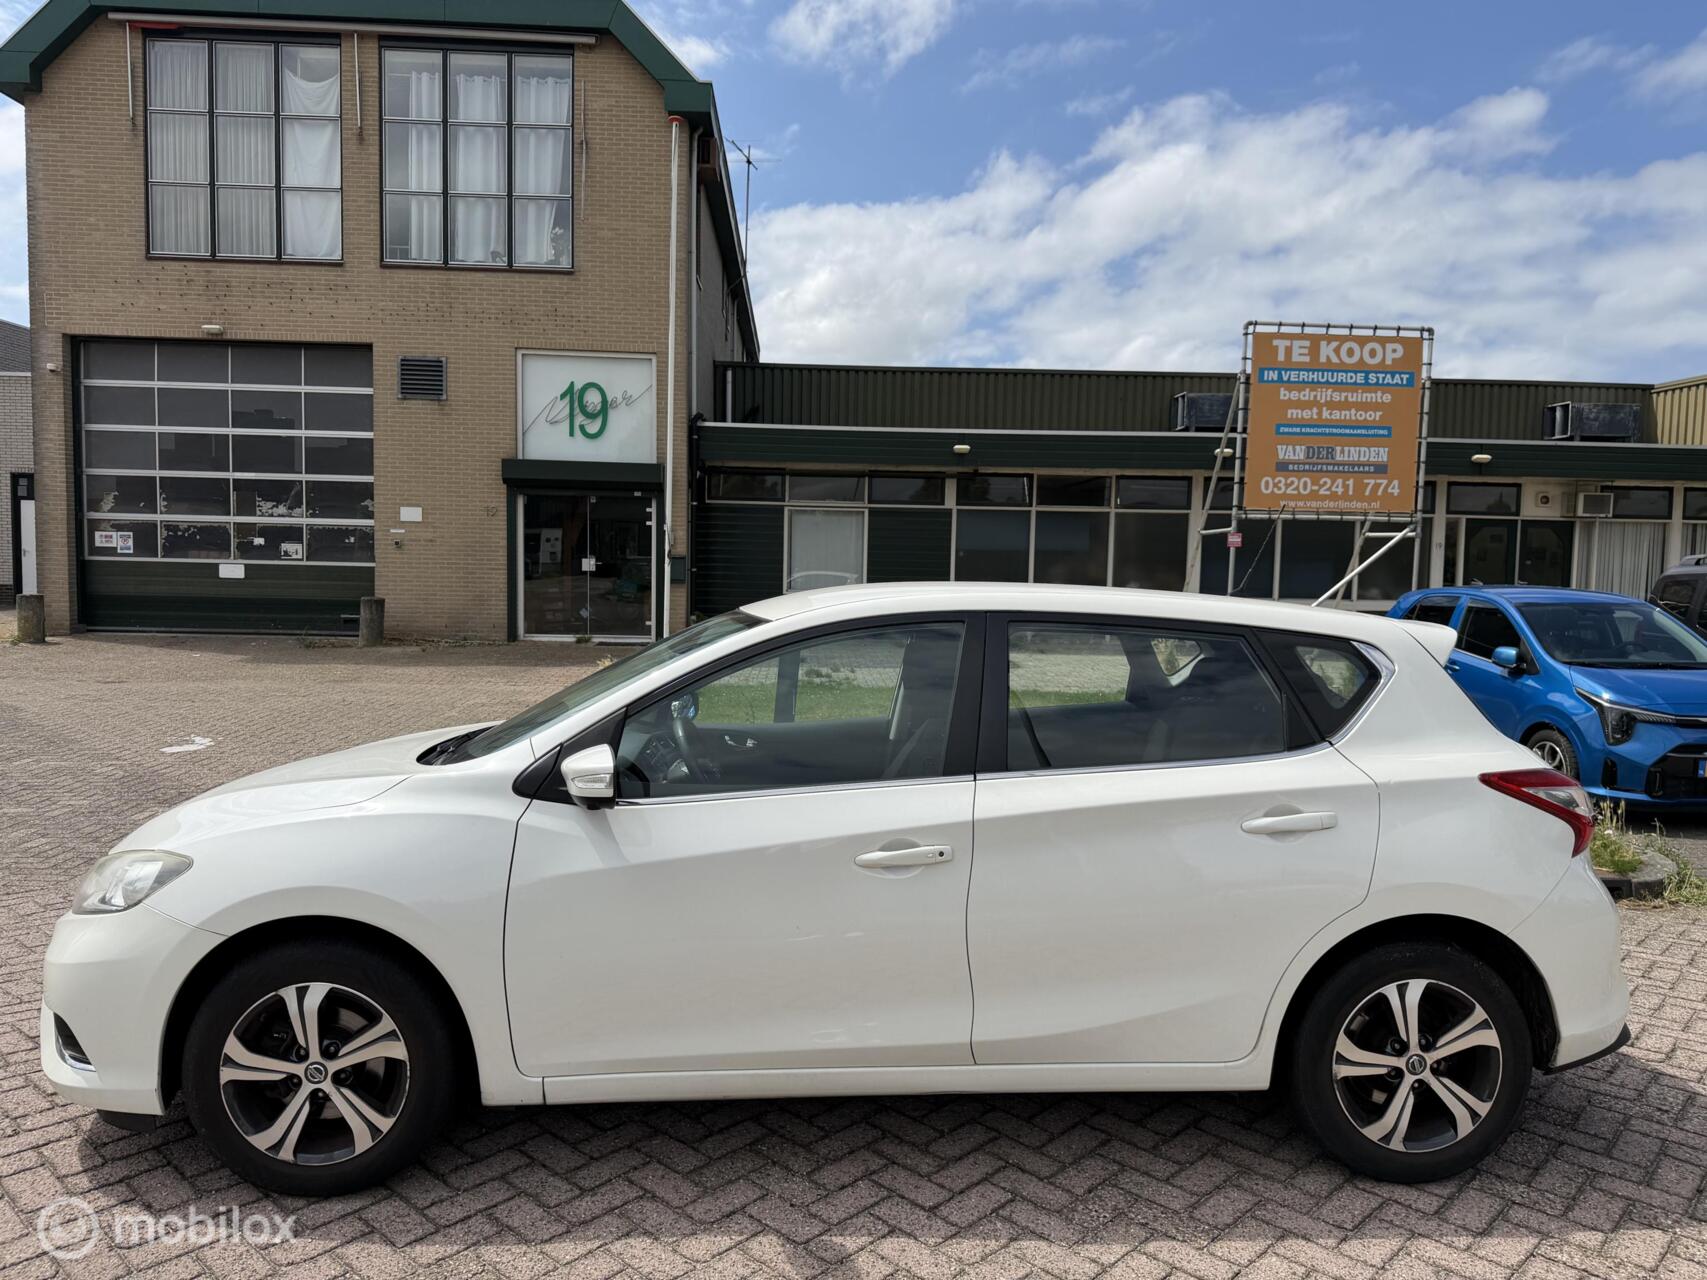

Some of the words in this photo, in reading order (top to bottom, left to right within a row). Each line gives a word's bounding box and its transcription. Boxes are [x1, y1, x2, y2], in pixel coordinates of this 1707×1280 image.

[1272, 339, 1310, 363] TE
[1319, 340, 1404, 365] KOOP
[1263, 370, 1278, 381] IN
[1281, 370, 1365, 384] VERHUURDE
[1368, 373, 1410, 385] STAAT
[1279, 387, 1392, 403] bedrijfsruimte
[560, 380, 609, 440] 19
[1287, 407, 1318, 419] met
[1322, 406, 1382, 421] kantoor
[1288, 464, 1375, 473] BEDRIJFSMAKELAARS
[1260, 476, 1355, 495] 0320-241
[1363, 479, 1400, 497] 774
[1280, 499, 1380, 509] www.vanderlinden.nl
